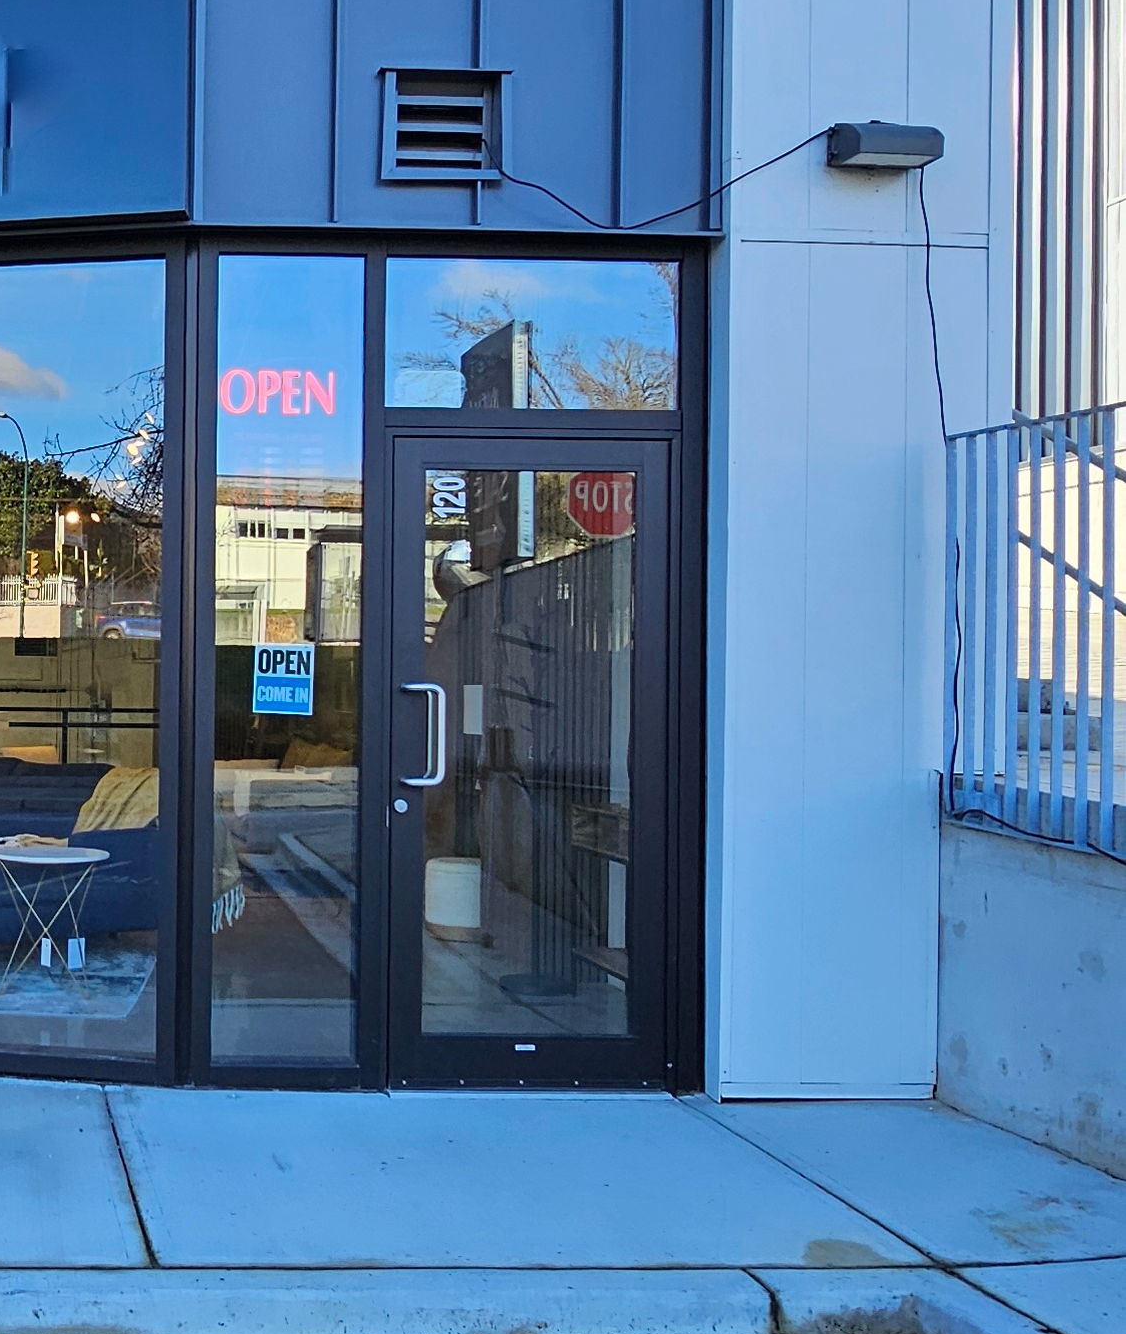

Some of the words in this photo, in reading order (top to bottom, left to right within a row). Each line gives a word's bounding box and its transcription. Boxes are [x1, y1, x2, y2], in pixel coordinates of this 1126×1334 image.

[220, 369, 335, 416] OPEN
[432, 476, 466, 519] 120
[258, 648, 311, 676] OPEN
[257, 685, 294, 703] COME
[295, 687, 309, 704] IN
